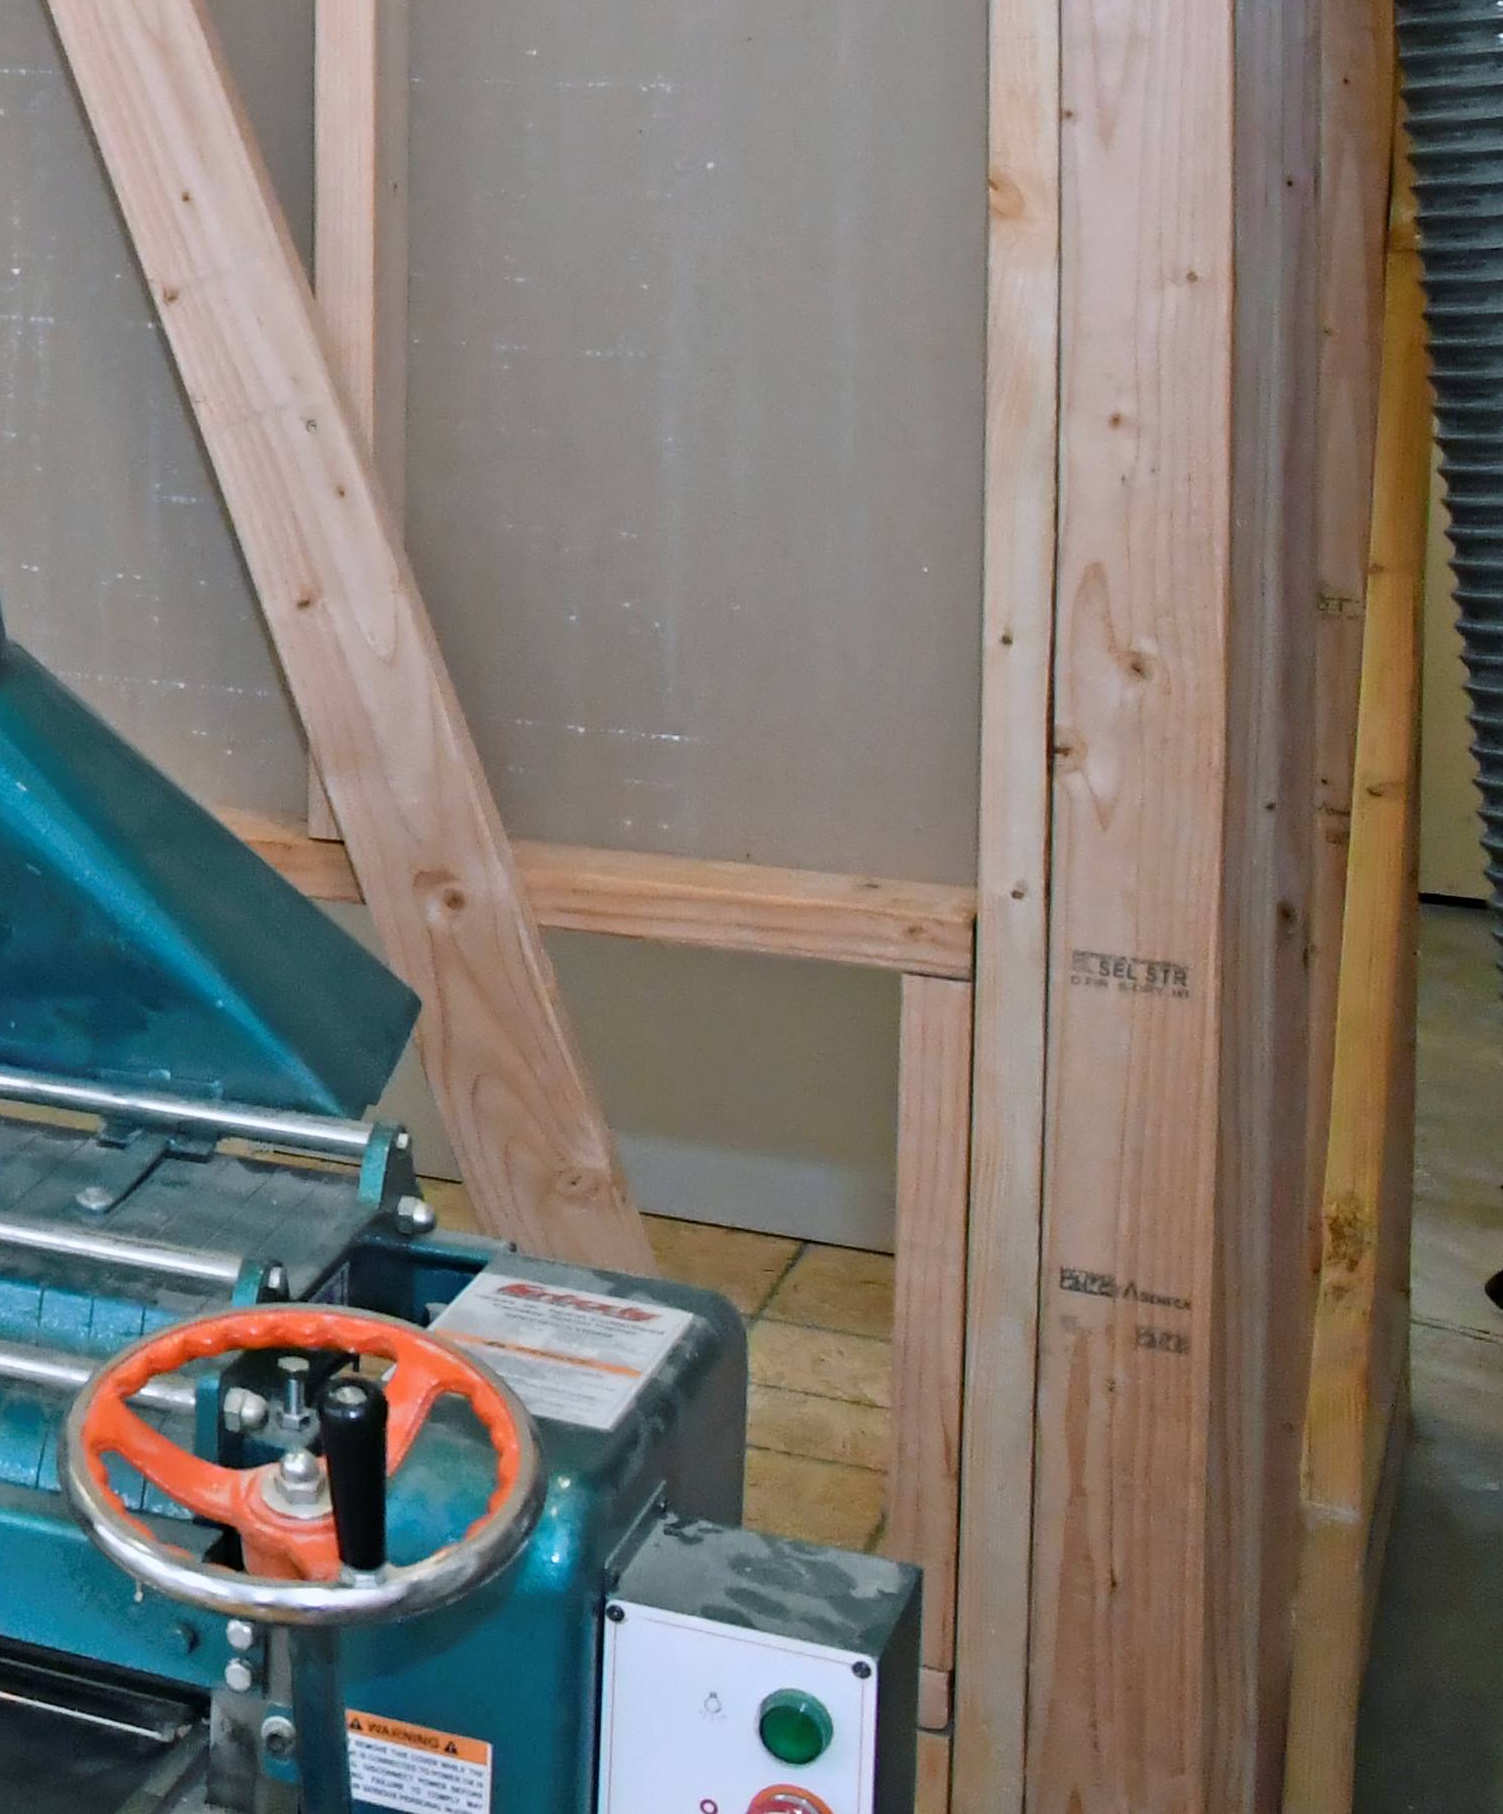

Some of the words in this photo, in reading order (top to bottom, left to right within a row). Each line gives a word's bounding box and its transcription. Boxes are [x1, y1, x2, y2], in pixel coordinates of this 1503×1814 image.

[1098, 958, 1138, 981] SEL
[1145, 962, 1188, 987] STR
[367, 1721, 441, 1749] WARNING
